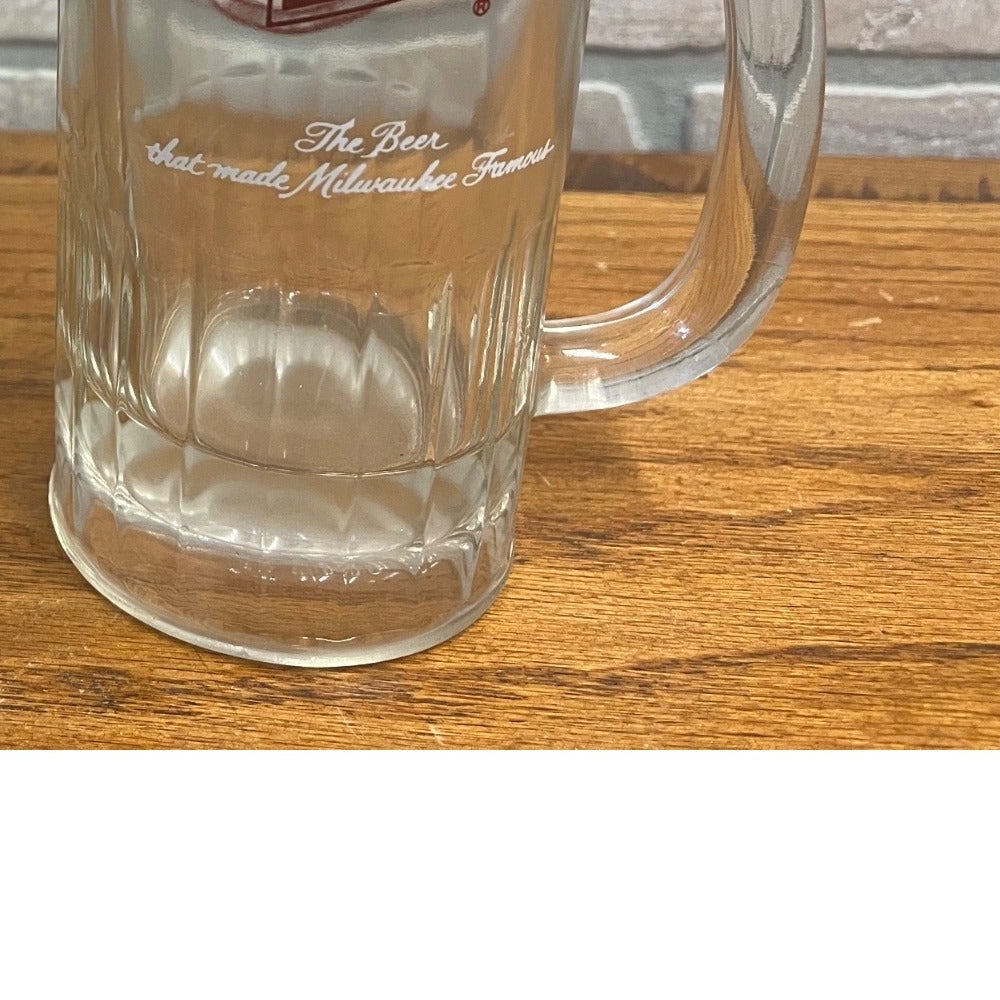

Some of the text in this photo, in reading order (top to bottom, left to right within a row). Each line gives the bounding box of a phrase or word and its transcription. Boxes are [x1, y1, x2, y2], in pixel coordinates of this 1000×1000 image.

[294, 118, 449, 158] The Beer
[145, 137, 555, 199] that made Milwaukee Famous
